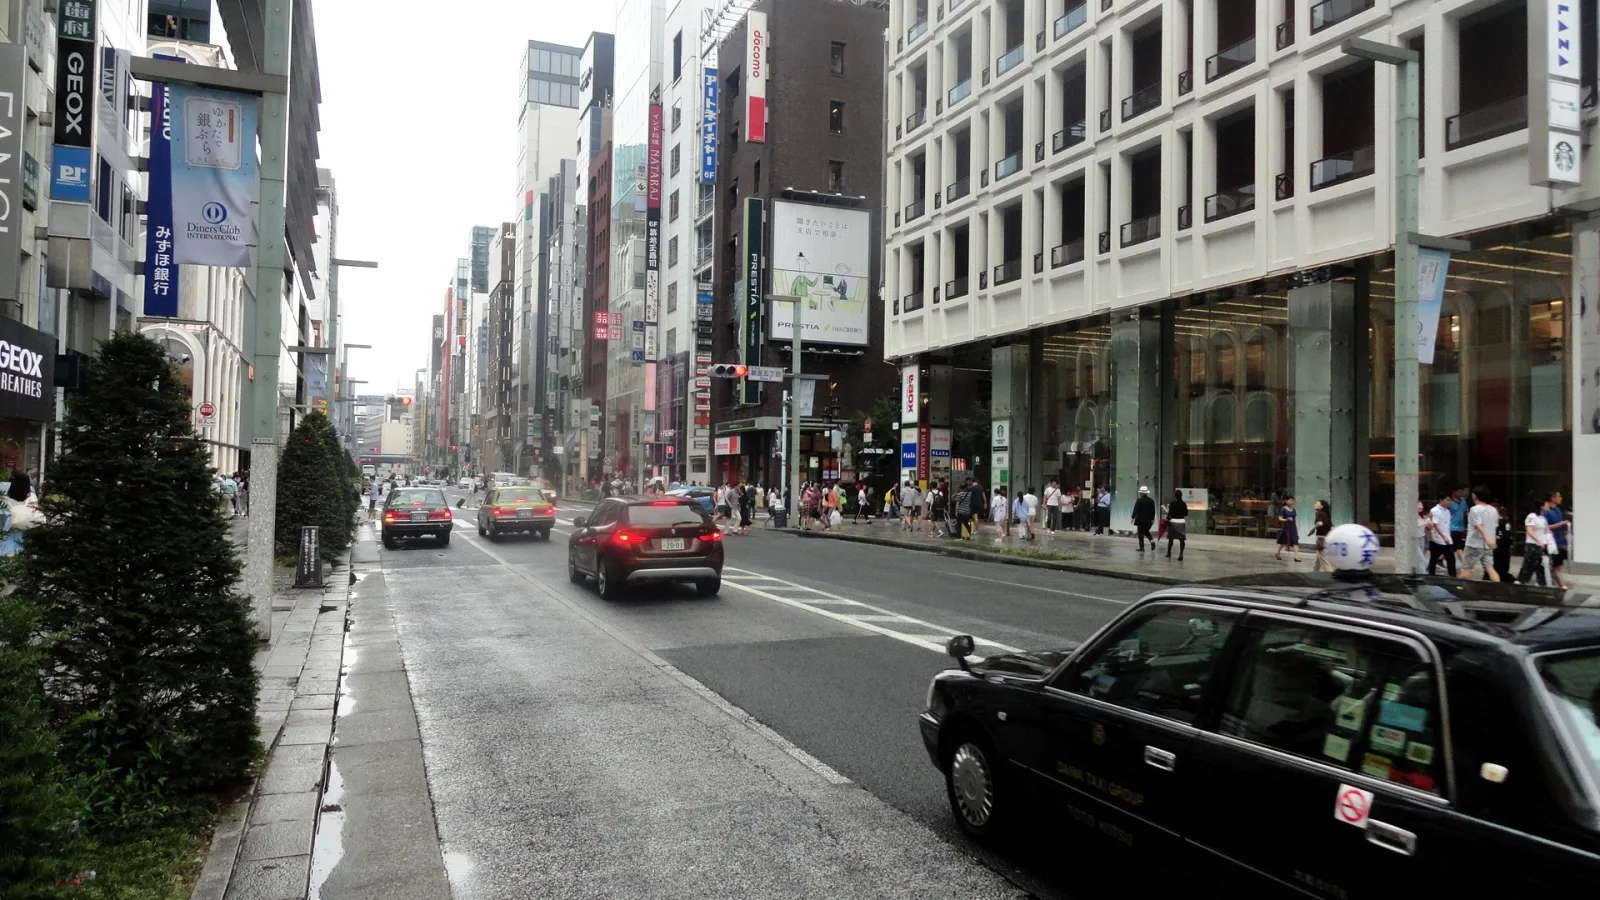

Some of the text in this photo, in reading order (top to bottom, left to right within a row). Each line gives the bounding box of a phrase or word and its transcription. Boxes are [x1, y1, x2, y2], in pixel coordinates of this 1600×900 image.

[753, 30, 762, 78] docomo
[66, 52, 84, 135] GEOX
[195, 113, 211, 155] 銀ぶら
[705, 74, 717, 165] アートネイチャー
[649, 150, 659, 201] NATARAJ
[187, 222, 240, 234] Diners Club
[187, 233, 239, 241] INTERNATIONAL
[797, 217, 848, 230] 聞きたいことは
[153, 226, 171, 295] みずほ銀行
[777, 321, 820, 331] PRSTIA
[0, 340, 43, 378] GEOX
[0, 372, 42, 398] REATHES
